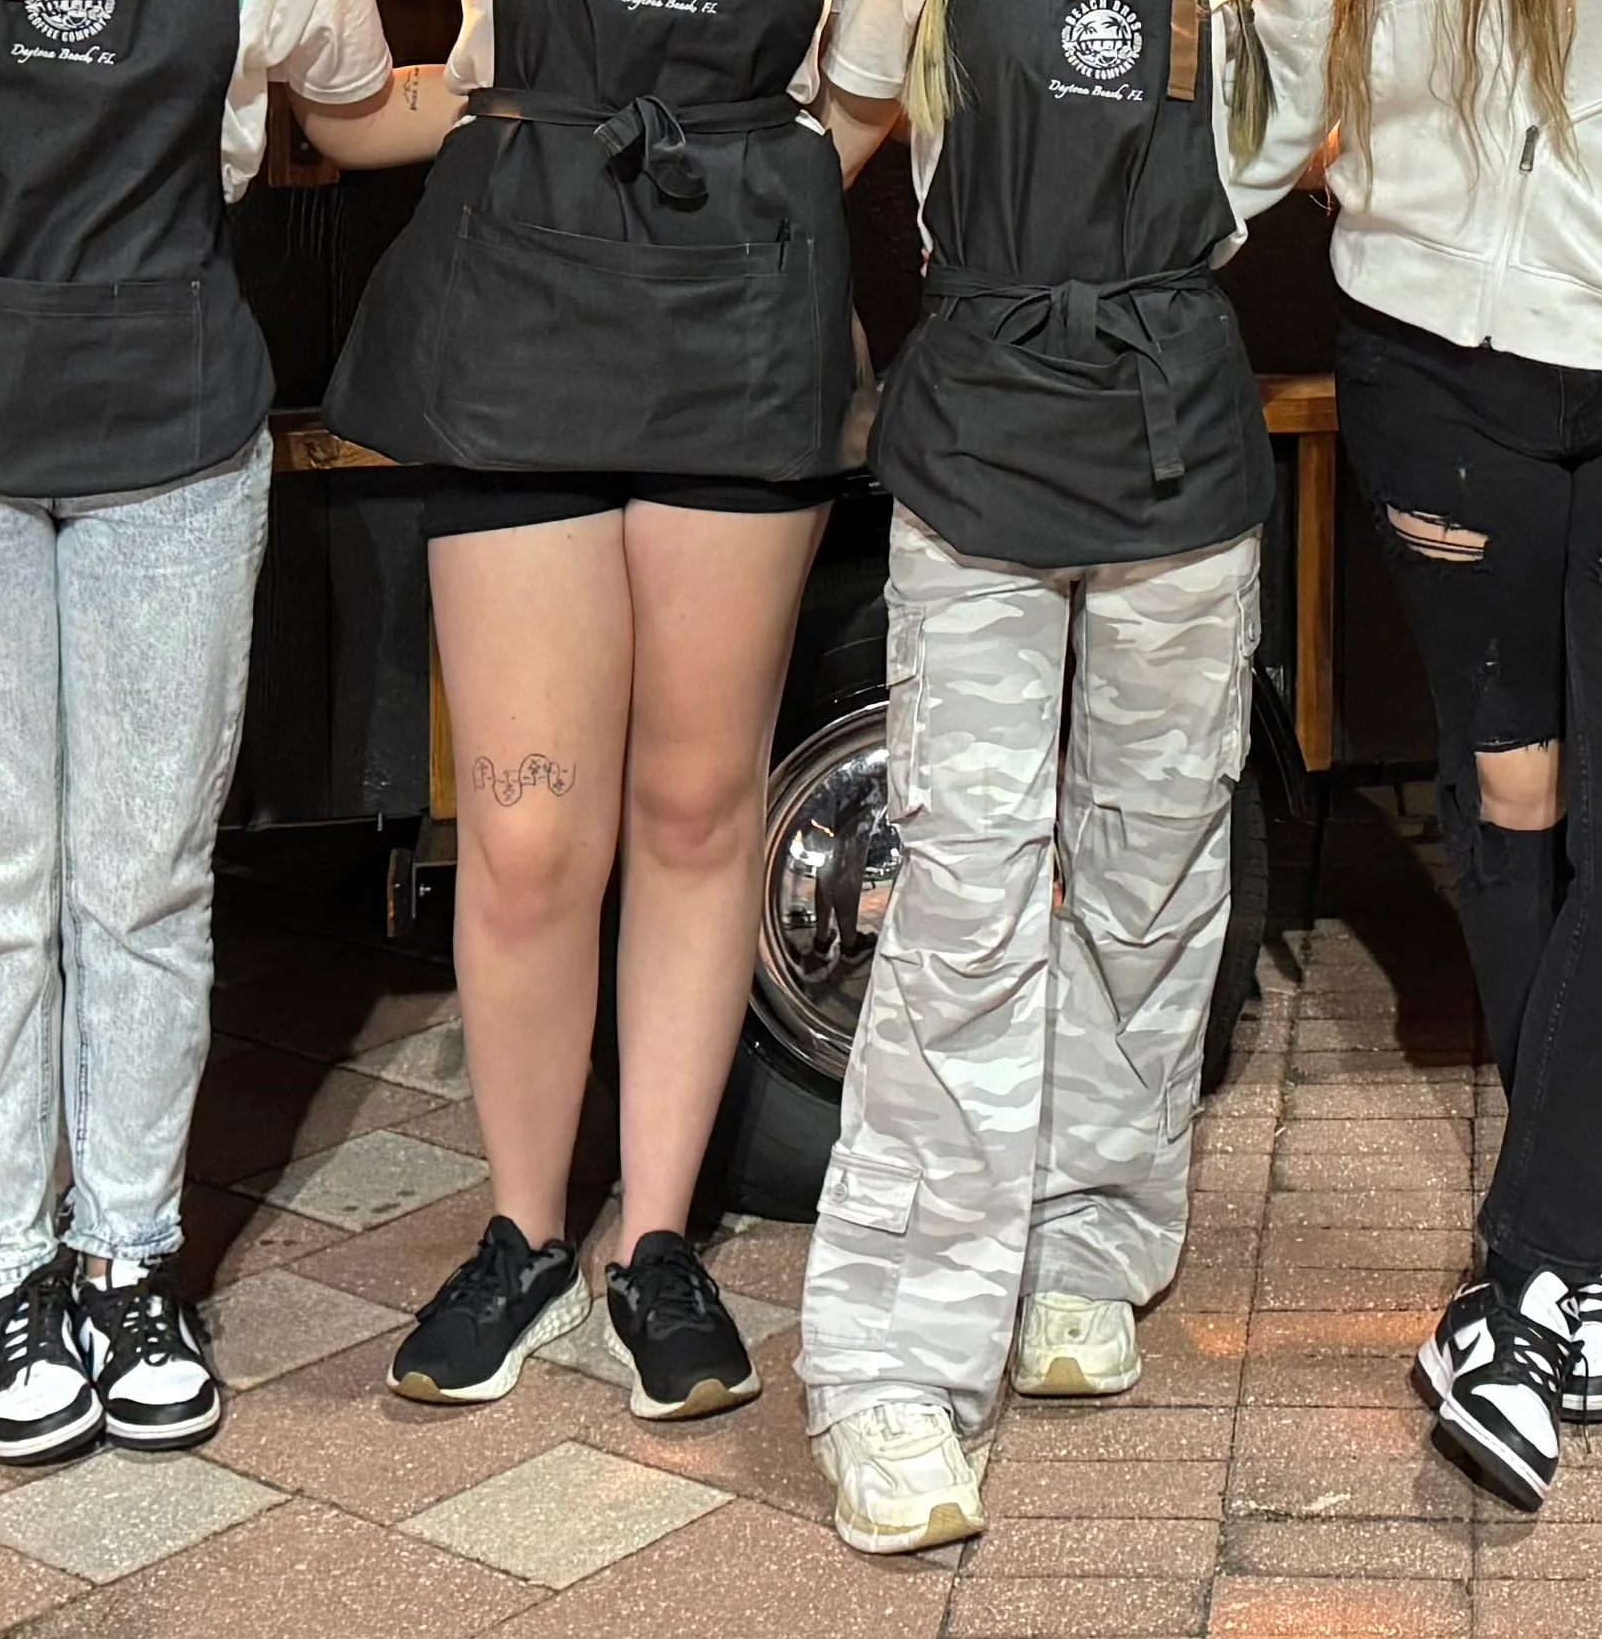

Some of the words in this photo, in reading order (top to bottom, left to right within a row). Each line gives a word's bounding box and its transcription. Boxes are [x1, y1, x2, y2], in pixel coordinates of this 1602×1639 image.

[27, 11, 60, 40] COFFEE
[61, 18, 111, 42] COMPANY
[1112, 0, 1142, 31] BROS
[1064, 48, 1092, 77] COFFEE
[1095, 54, 1139, 80] COMPANY
